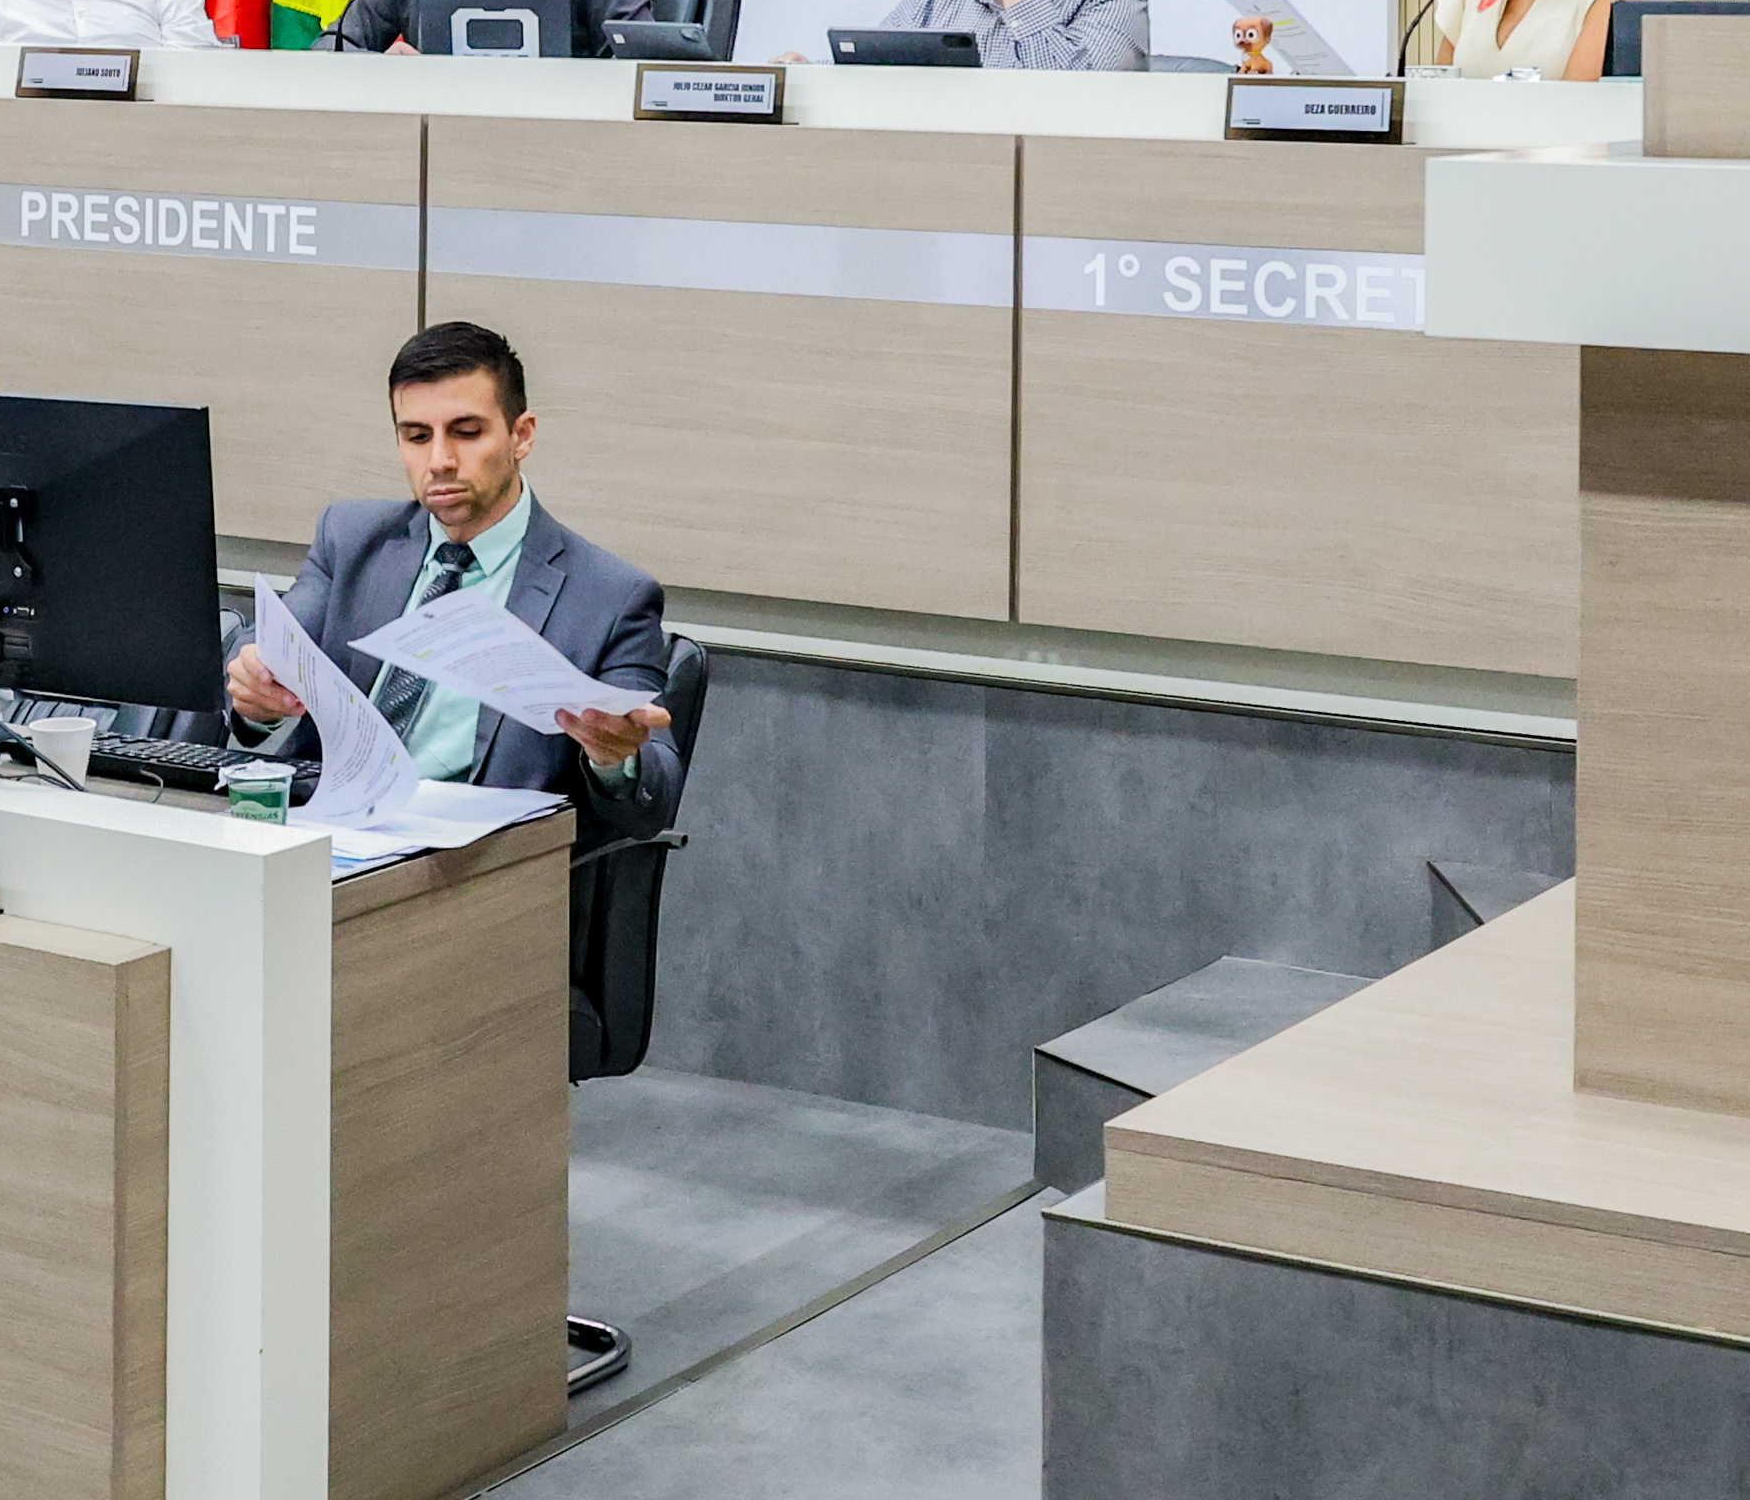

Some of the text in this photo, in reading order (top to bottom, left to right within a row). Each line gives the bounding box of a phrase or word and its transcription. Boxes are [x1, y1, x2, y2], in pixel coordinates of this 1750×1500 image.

[1304, 103, 1377, 115] DEZA GUERREIRO
[20, 191, 318, 256] PRESIDENTE
